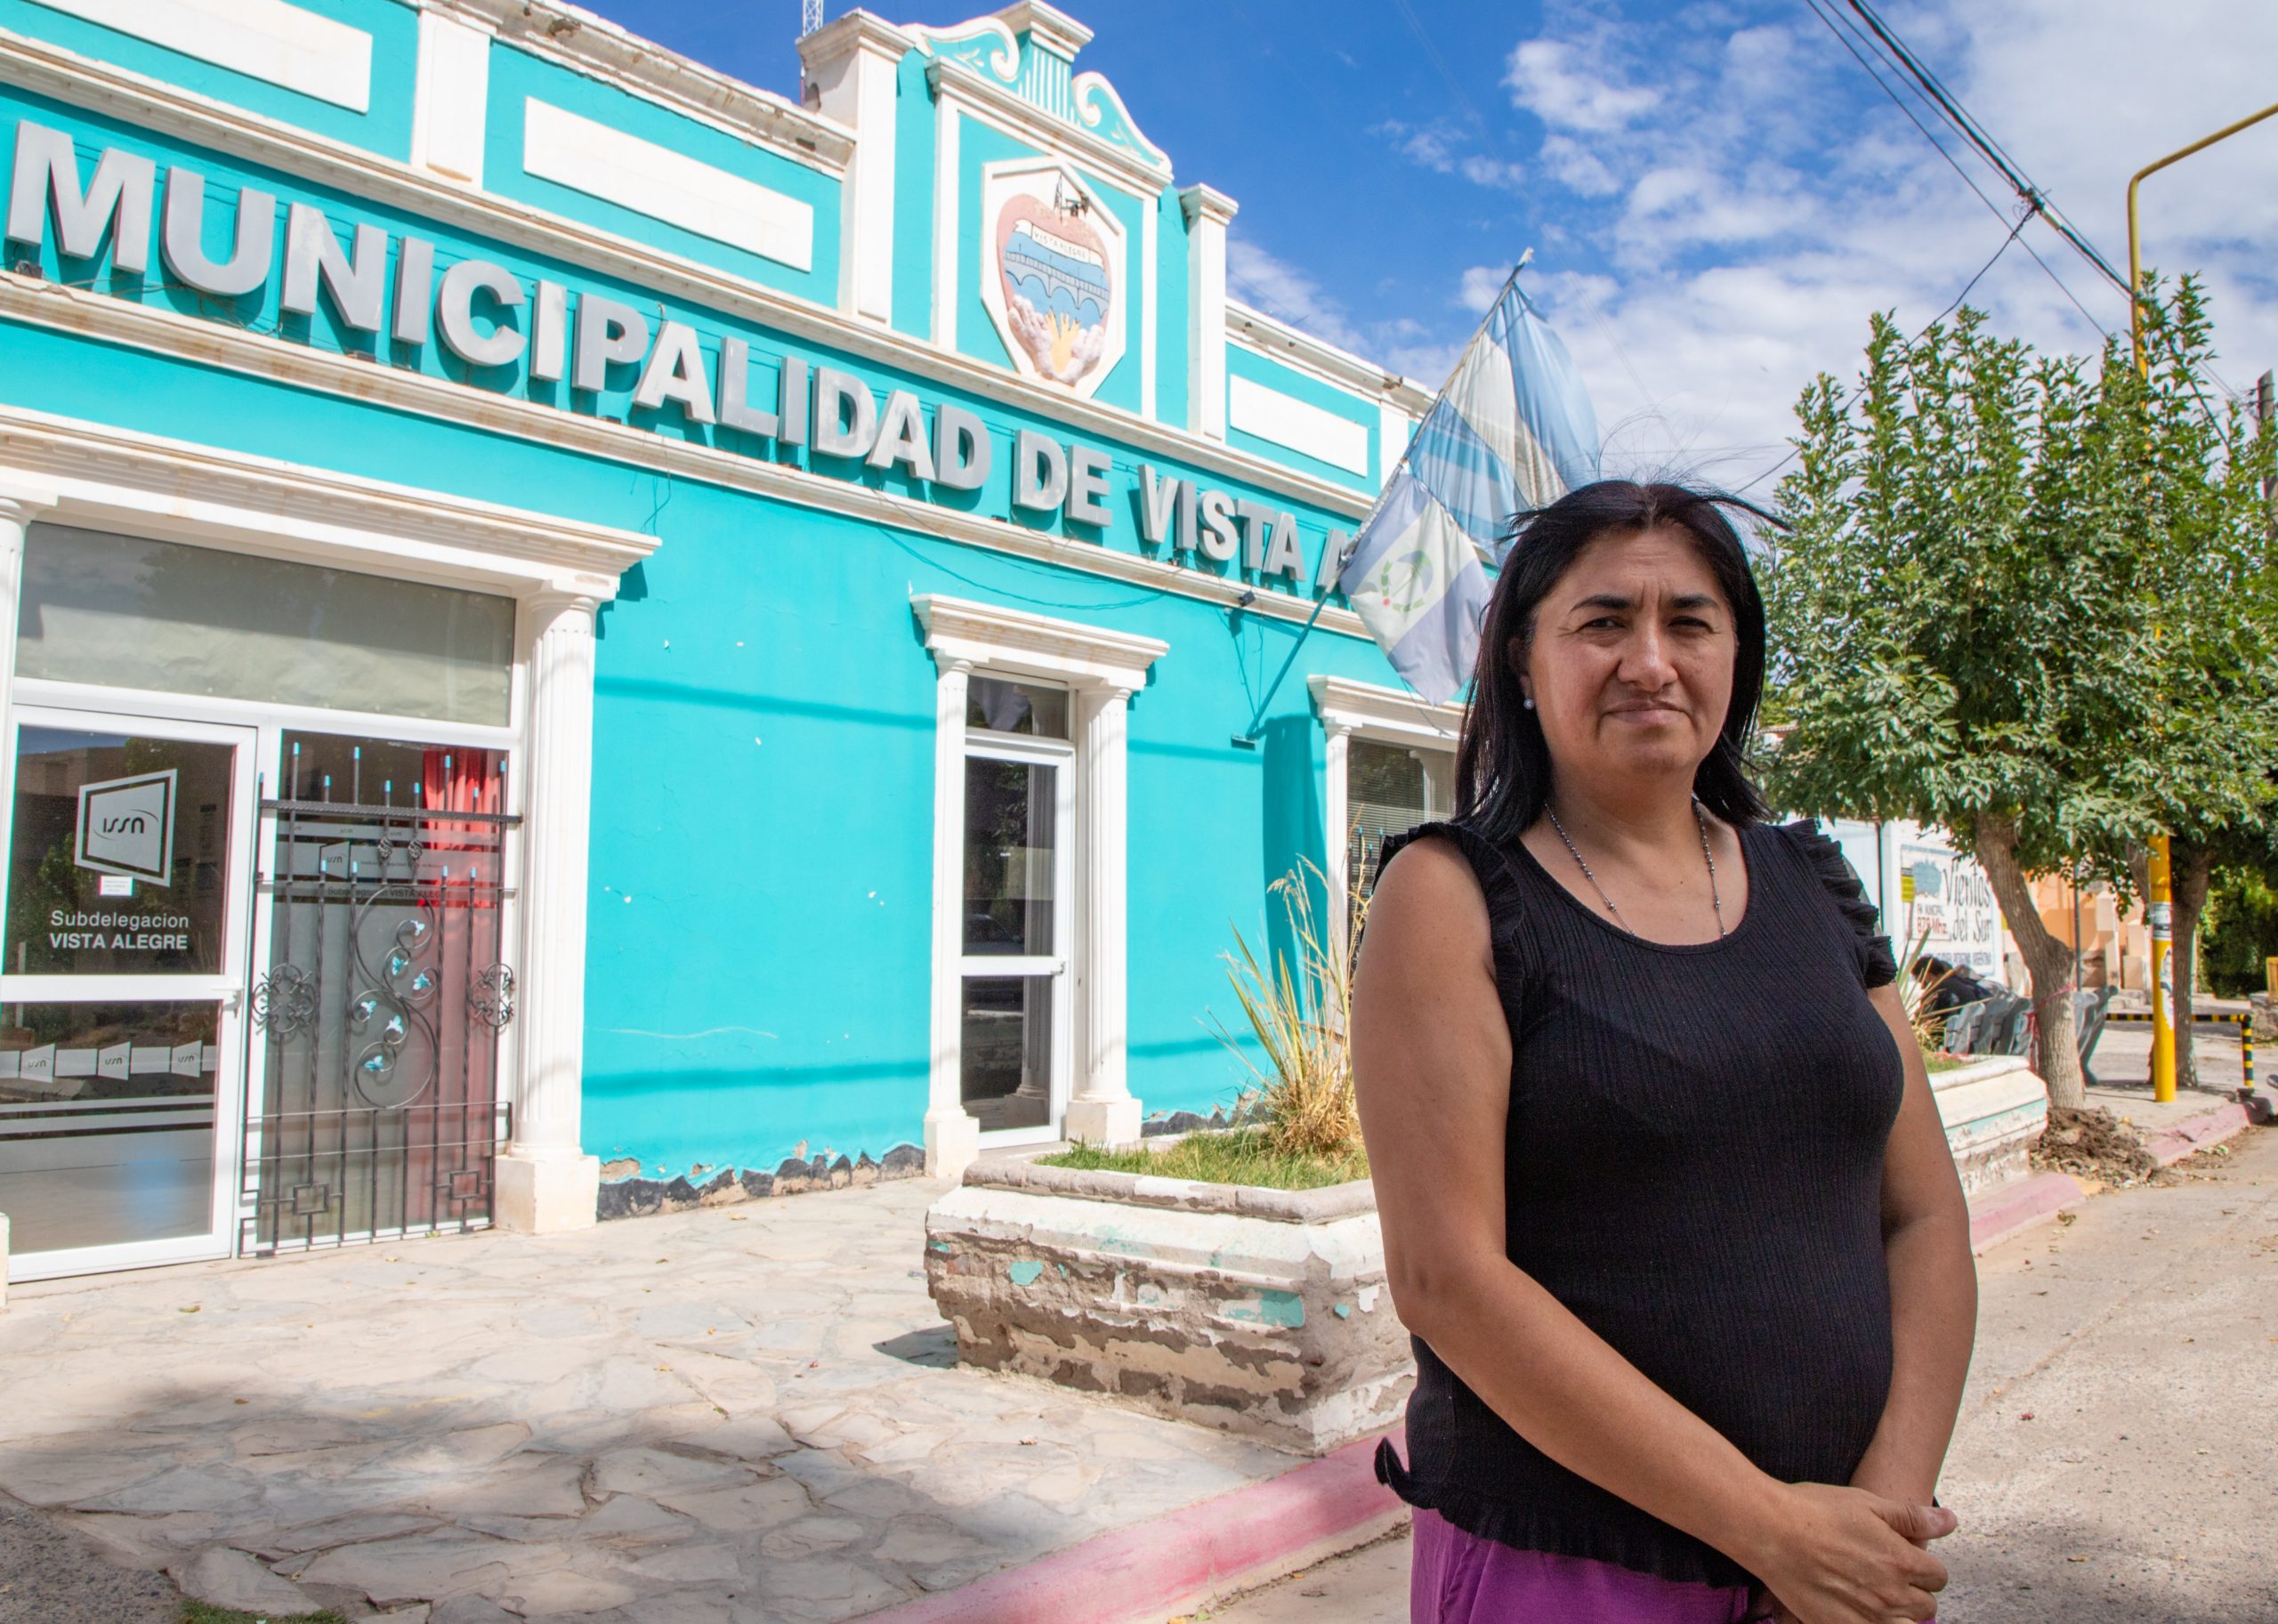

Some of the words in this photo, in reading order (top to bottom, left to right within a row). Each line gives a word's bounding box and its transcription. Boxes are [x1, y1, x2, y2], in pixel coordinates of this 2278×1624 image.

[6, 120, 991, 490] MUNICIPALIDAD
[1012, 429, 1113, 527] DE
[1138, 464, 1306, 581] VISTA
[1943, 857, 1991, 907] Vientos
[51, 909, 190, 932] Subdelegacion
[1952, 907, 1967, 941] del
[1973, 909, 1991, 942] Sur
[49, 933, 106, 949] VISTA
[111, 934, 189, 950] ALEGRE
